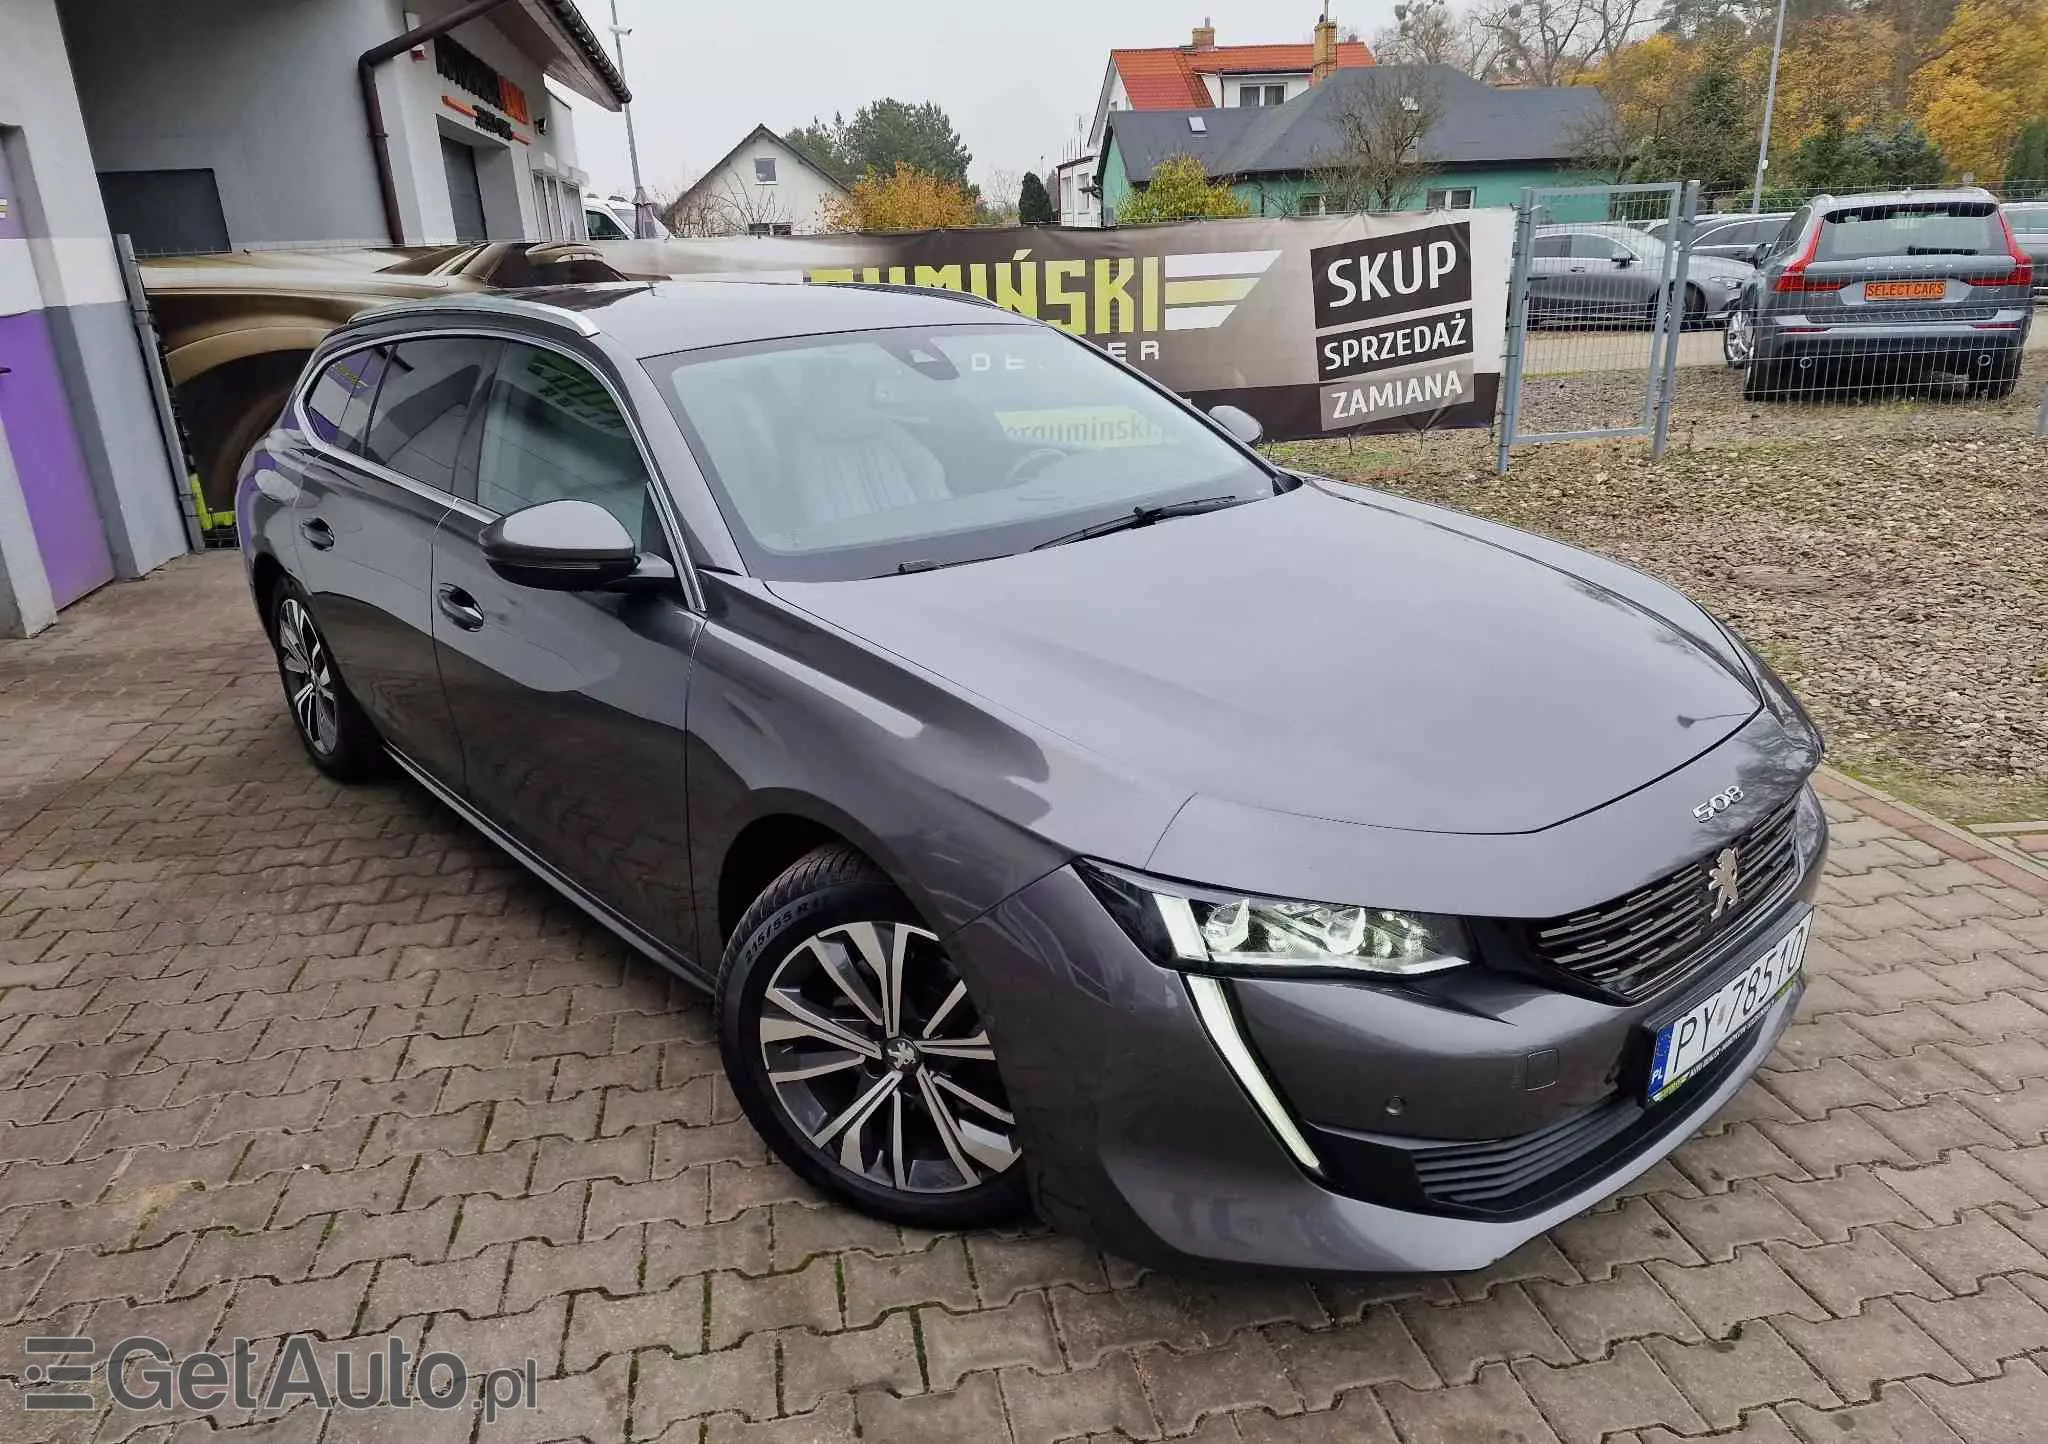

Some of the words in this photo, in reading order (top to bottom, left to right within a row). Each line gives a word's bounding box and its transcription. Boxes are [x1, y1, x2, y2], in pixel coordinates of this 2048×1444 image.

[1327, 240, 1457, 308] SKUP
[1867, 284, 1913, 297] SELECT
[1323, 313, 1467, 370] SPRZEDAŻ
[1331, 370, 1463, 419] ZAMIANA
[1692, 785, 1744, 822] 508
[1673, 997, 1720, 1074] PY
[1724, 926, 1805, 1034] 78510
[1651, 1067, 1664, 1087] PL
